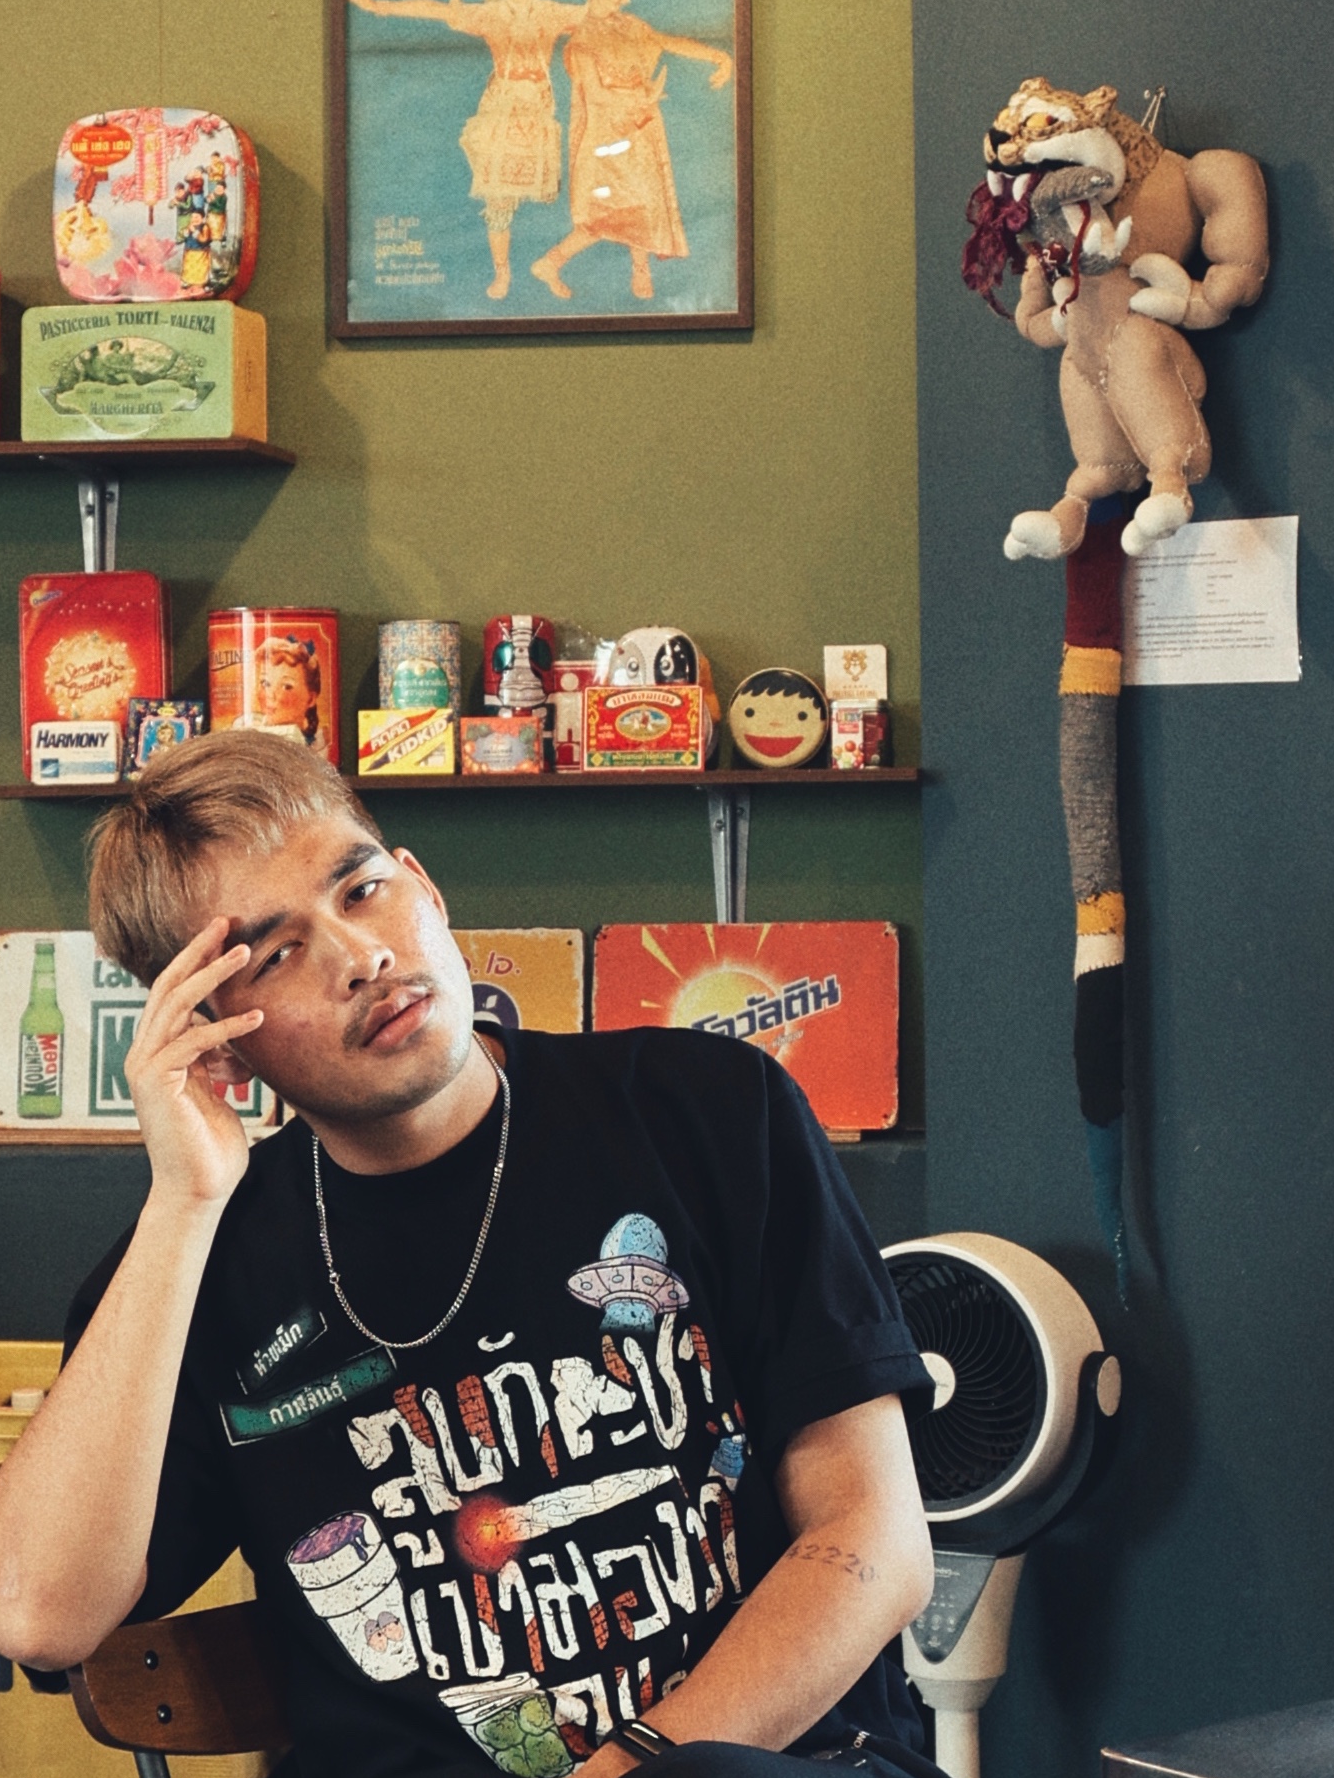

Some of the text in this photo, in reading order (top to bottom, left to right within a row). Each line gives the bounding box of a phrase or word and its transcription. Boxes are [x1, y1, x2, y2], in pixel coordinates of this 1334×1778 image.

[40, 310, 216, 341] PASTICCERIA TORTI VALENZA
[35, 728, 110, 749] HARMONY
